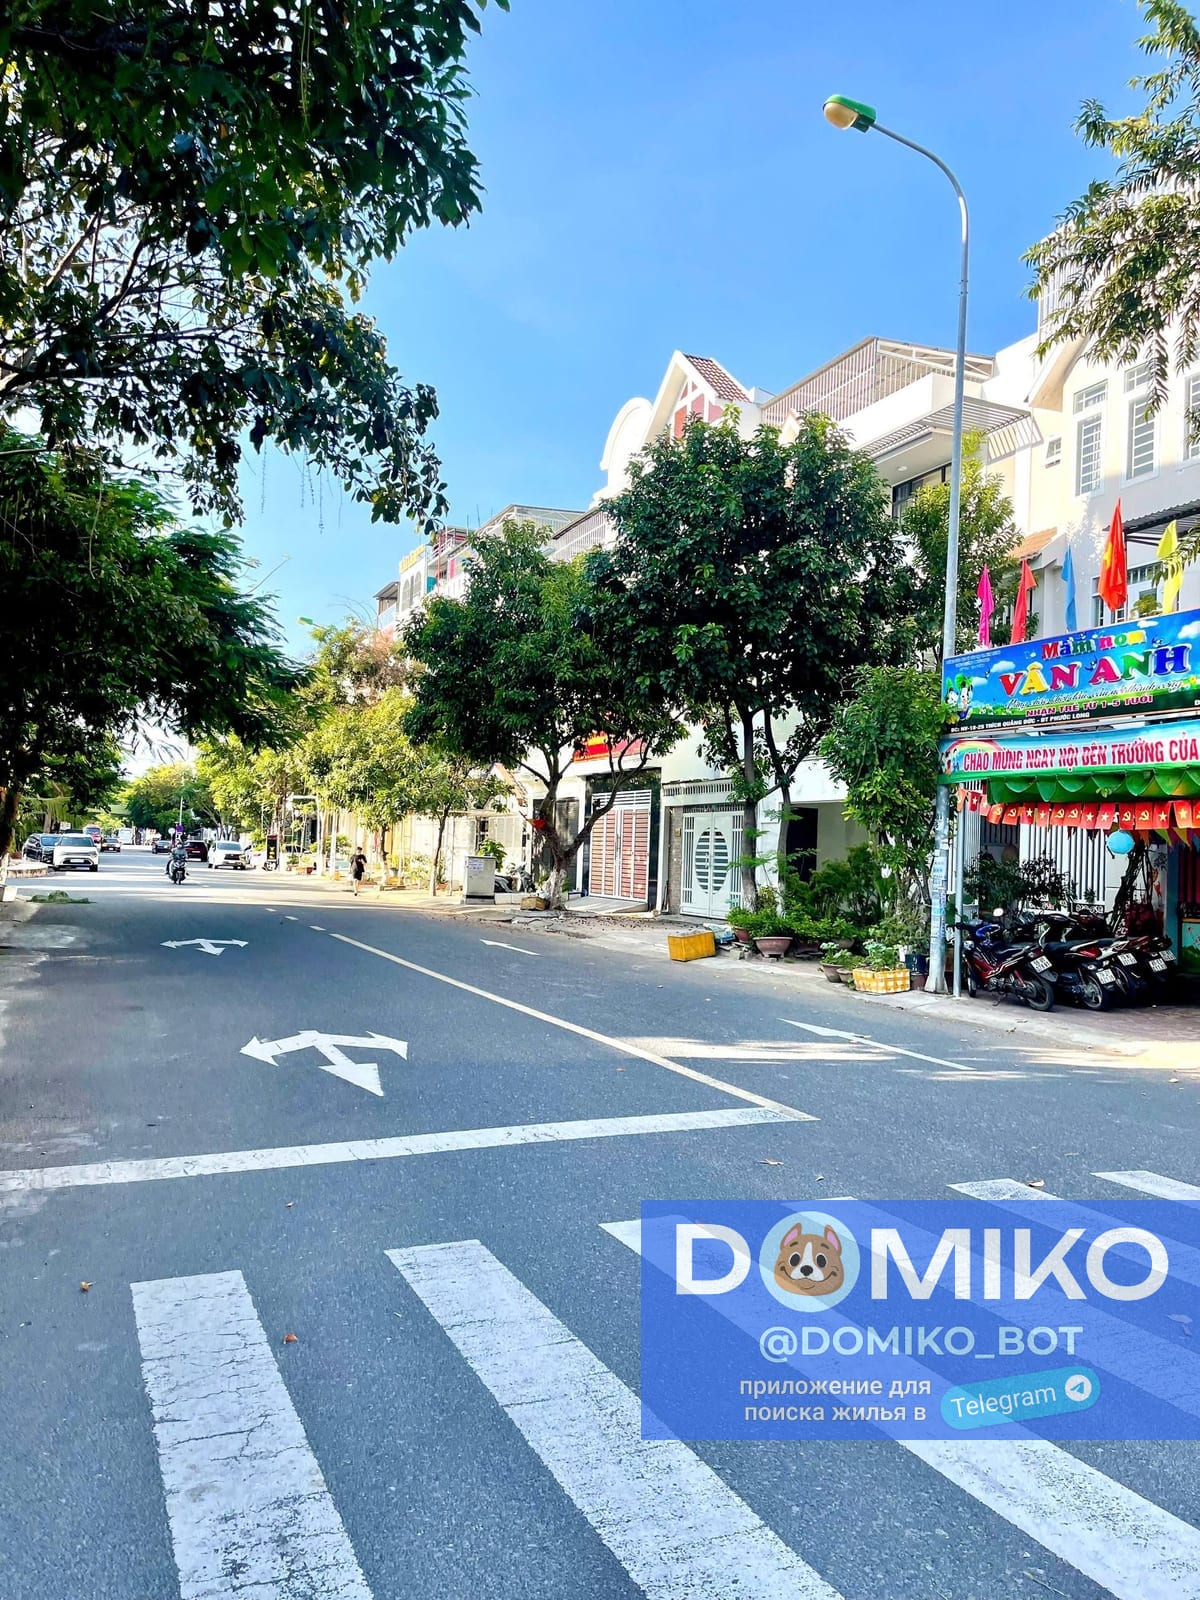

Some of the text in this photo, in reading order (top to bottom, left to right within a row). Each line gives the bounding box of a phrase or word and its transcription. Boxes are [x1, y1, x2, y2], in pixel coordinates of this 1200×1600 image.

[1098, 630, 1147, 651] non
[999, 644, 1191, 696] VÂN ANH
[1072, 712, 1090, 720] LONG
[963, 732, 1200, 772] CHÀO MỪNG NGÀY HỘI ĐẾN TRƯỜNG CỦA
